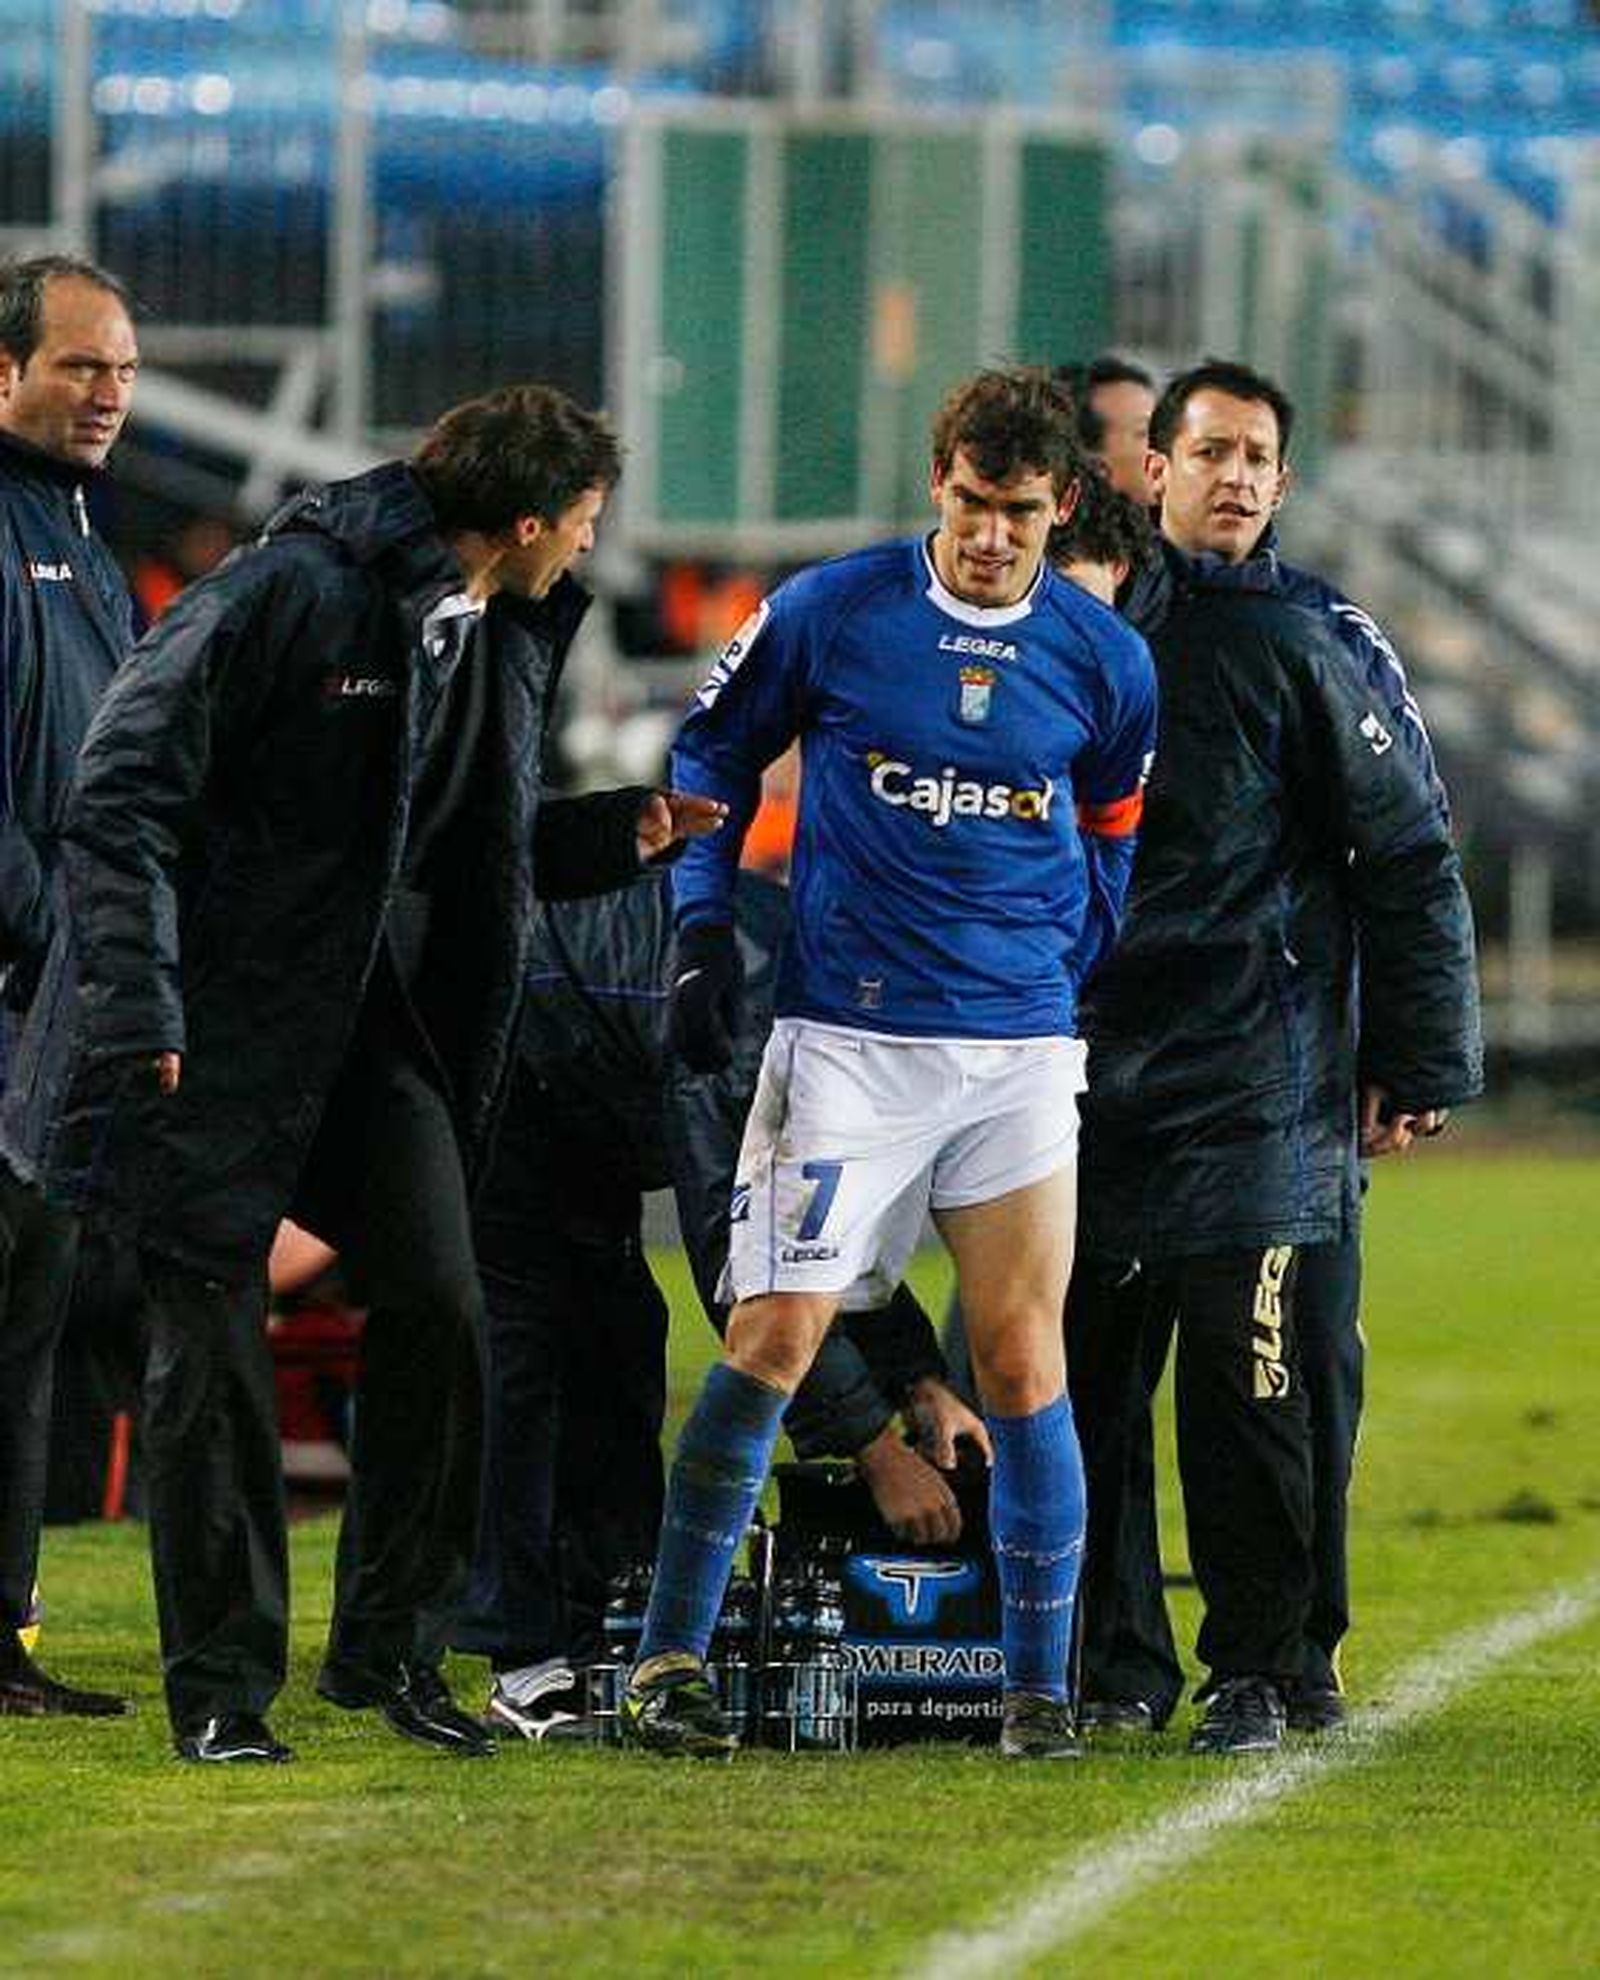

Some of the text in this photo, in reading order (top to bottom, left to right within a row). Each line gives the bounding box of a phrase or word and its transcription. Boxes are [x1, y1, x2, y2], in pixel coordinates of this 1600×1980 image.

[938, 634, 1016, 660] LEGEA
[870, 760, 1055, 827] Cajasol
[797, 1160, 843, 1241] 7
[1253, 1245, 1292, 1361] LEG
[839, 1644, 1005, 1678] OWERAD
[866, 1697, 1005, 1721] para deporti
